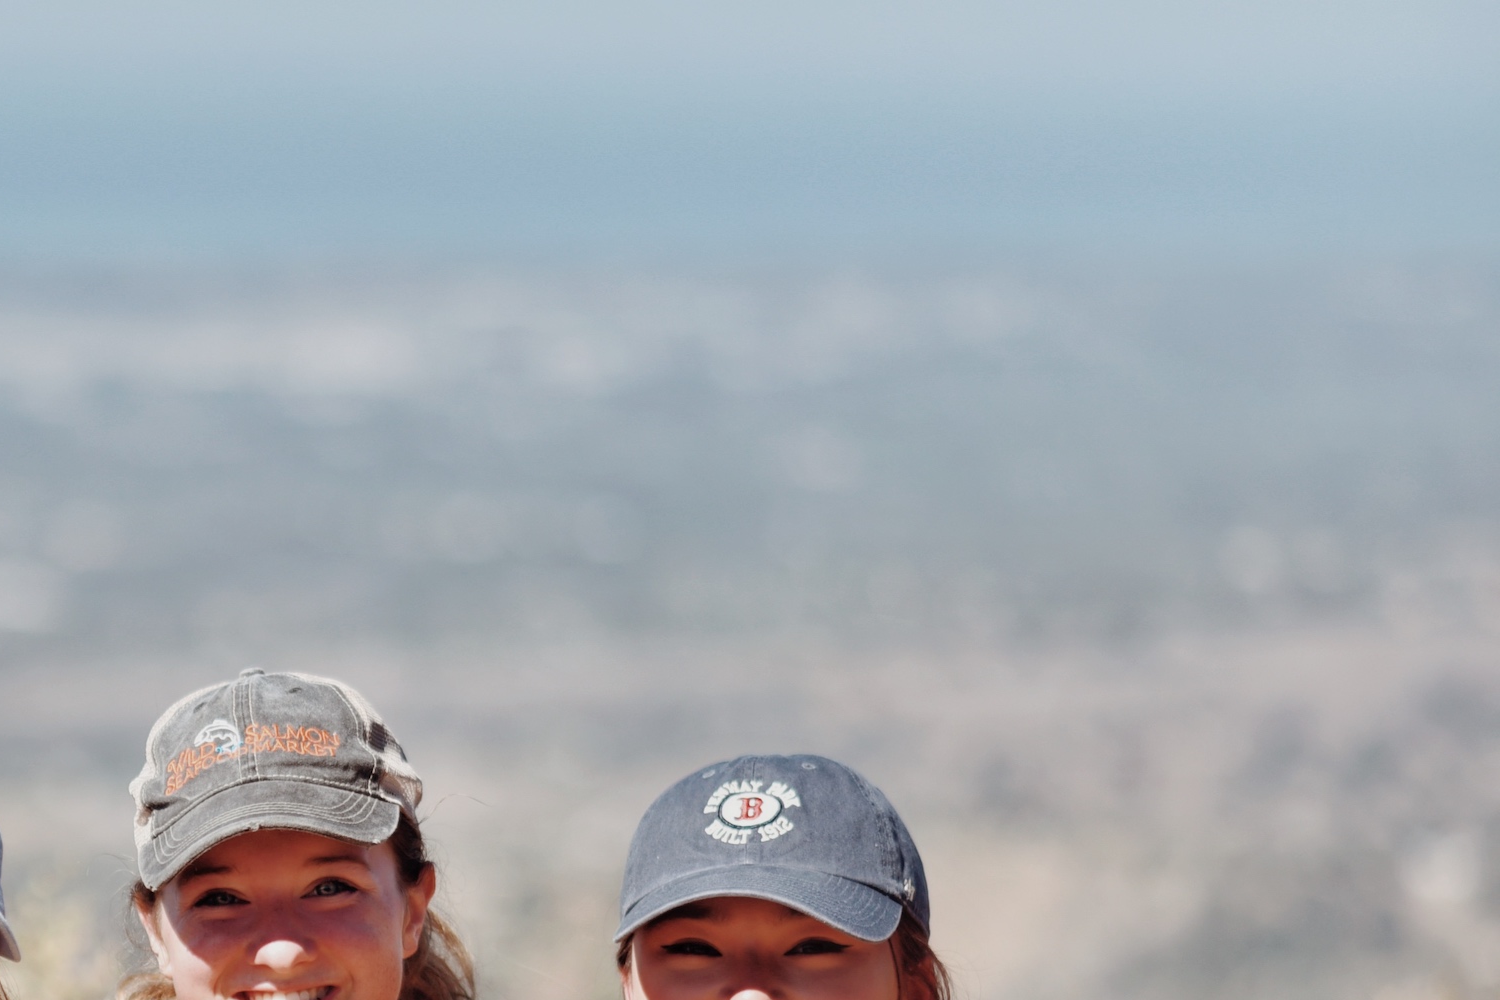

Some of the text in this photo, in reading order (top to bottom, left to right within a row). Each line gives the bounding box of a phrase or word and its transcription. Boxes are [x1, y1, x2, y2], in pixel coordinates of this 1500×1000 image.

[164, 739, 338, 796] SEAFOOD MARKET
[167, 723, 341, 776] WILD SALMON
[733, 797, 764, 821] B
[704, 816, 794, 845] BUILT 1912
